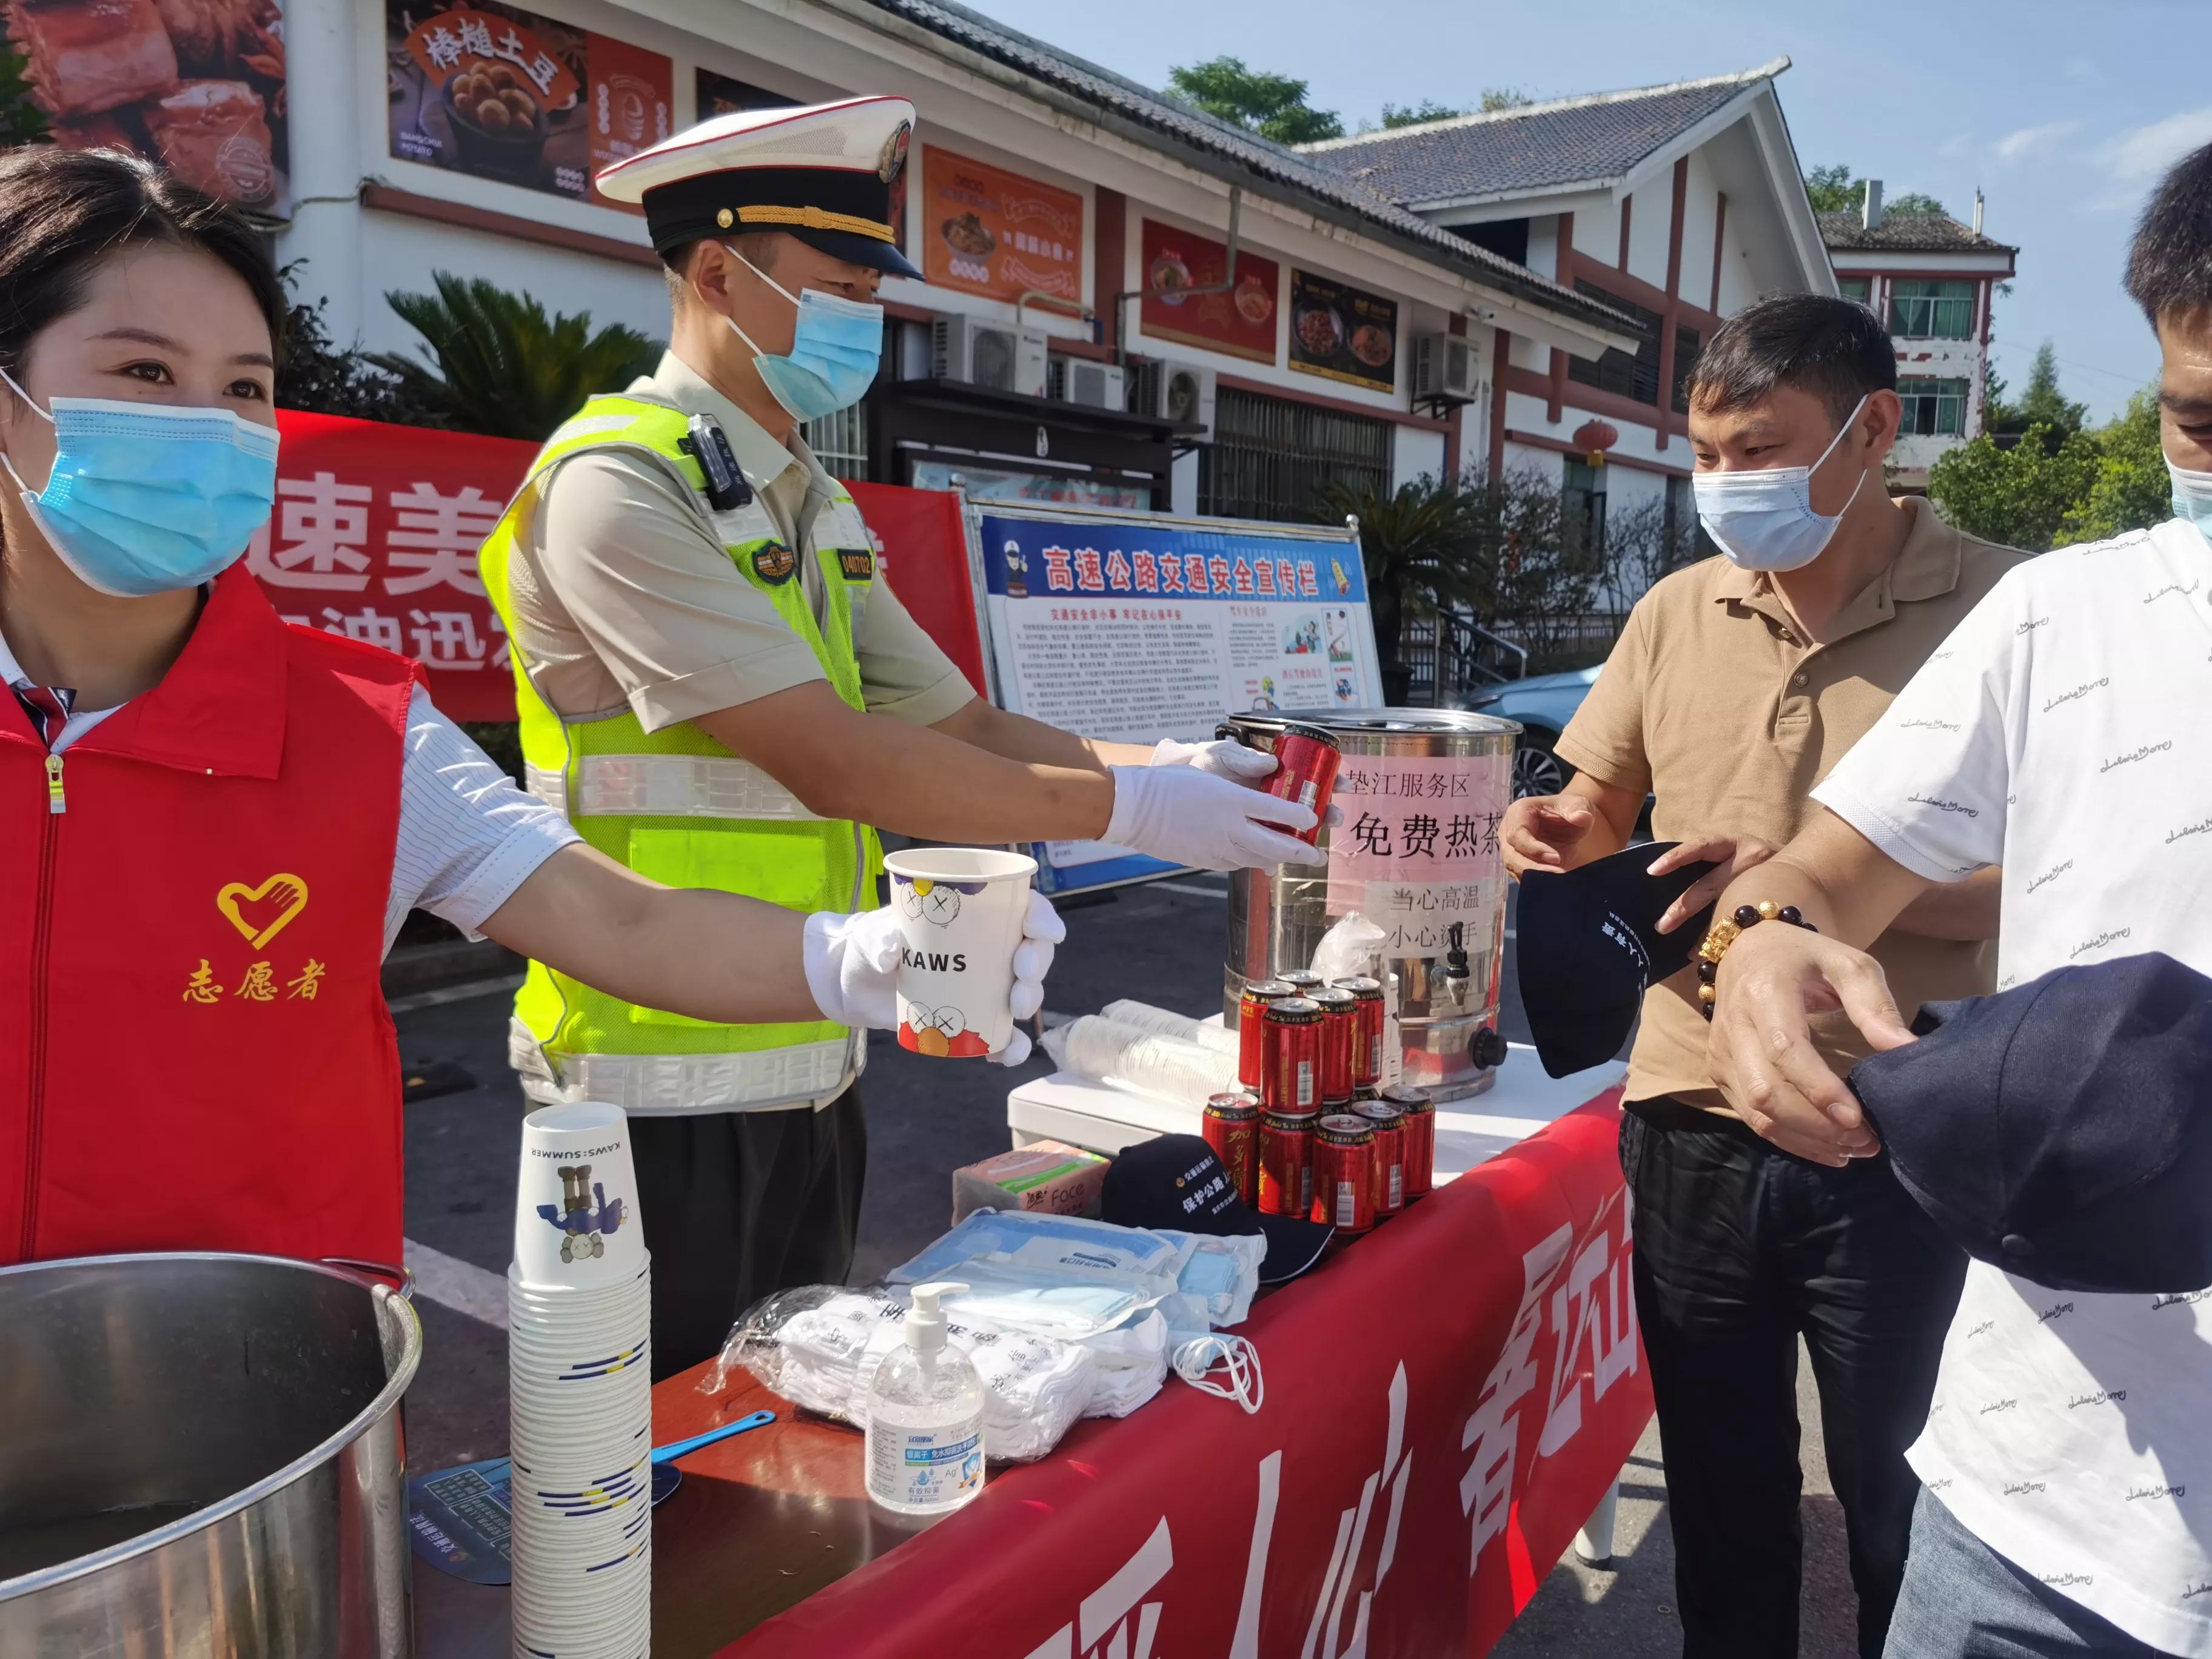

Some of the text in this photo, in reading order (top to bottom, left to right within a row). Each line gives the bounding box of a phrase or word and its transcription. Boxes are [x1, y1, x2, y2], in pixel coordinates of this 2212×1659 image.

[1042, 546, 1319, 597] 高速公路交通安全宣传栏
[1346, 769, 1471, 799] 垫江服务区
[1349, 810, 1504, 859] 免费热茶
[1390, 885, 1480, 912] 当心高温
[1388, 922, 1478, 949] 小心烫手
[1601, 922, 1644, 968] 人人有责
[902, 946, 967, 973] KAWS
[182, 958, 326, 1004] 志愿者
[531, 1141, 621, 1159] KAWS:SUMMER
[908, 1486, 939, 1495] 有效抑菌
